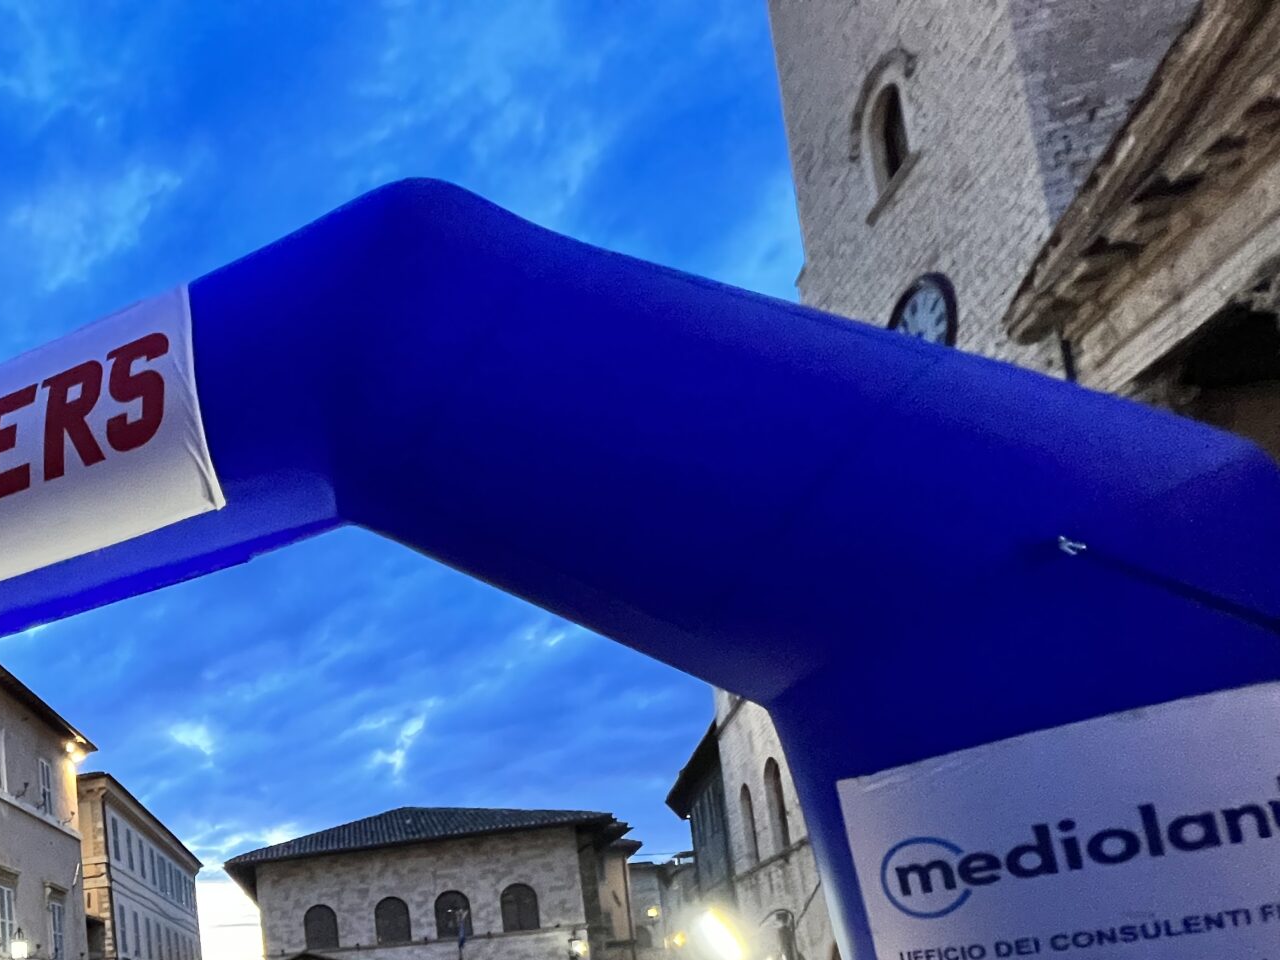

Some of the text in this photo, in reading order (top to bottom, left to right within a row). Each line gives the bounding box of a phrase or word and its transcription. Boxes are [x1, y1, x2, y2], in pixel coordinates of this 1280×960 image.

[895, 801, 1280, 896] mediolan
[995, 937, 1040, 957] DEI
[1049, 908, 1252, 952] CONSULENTI
